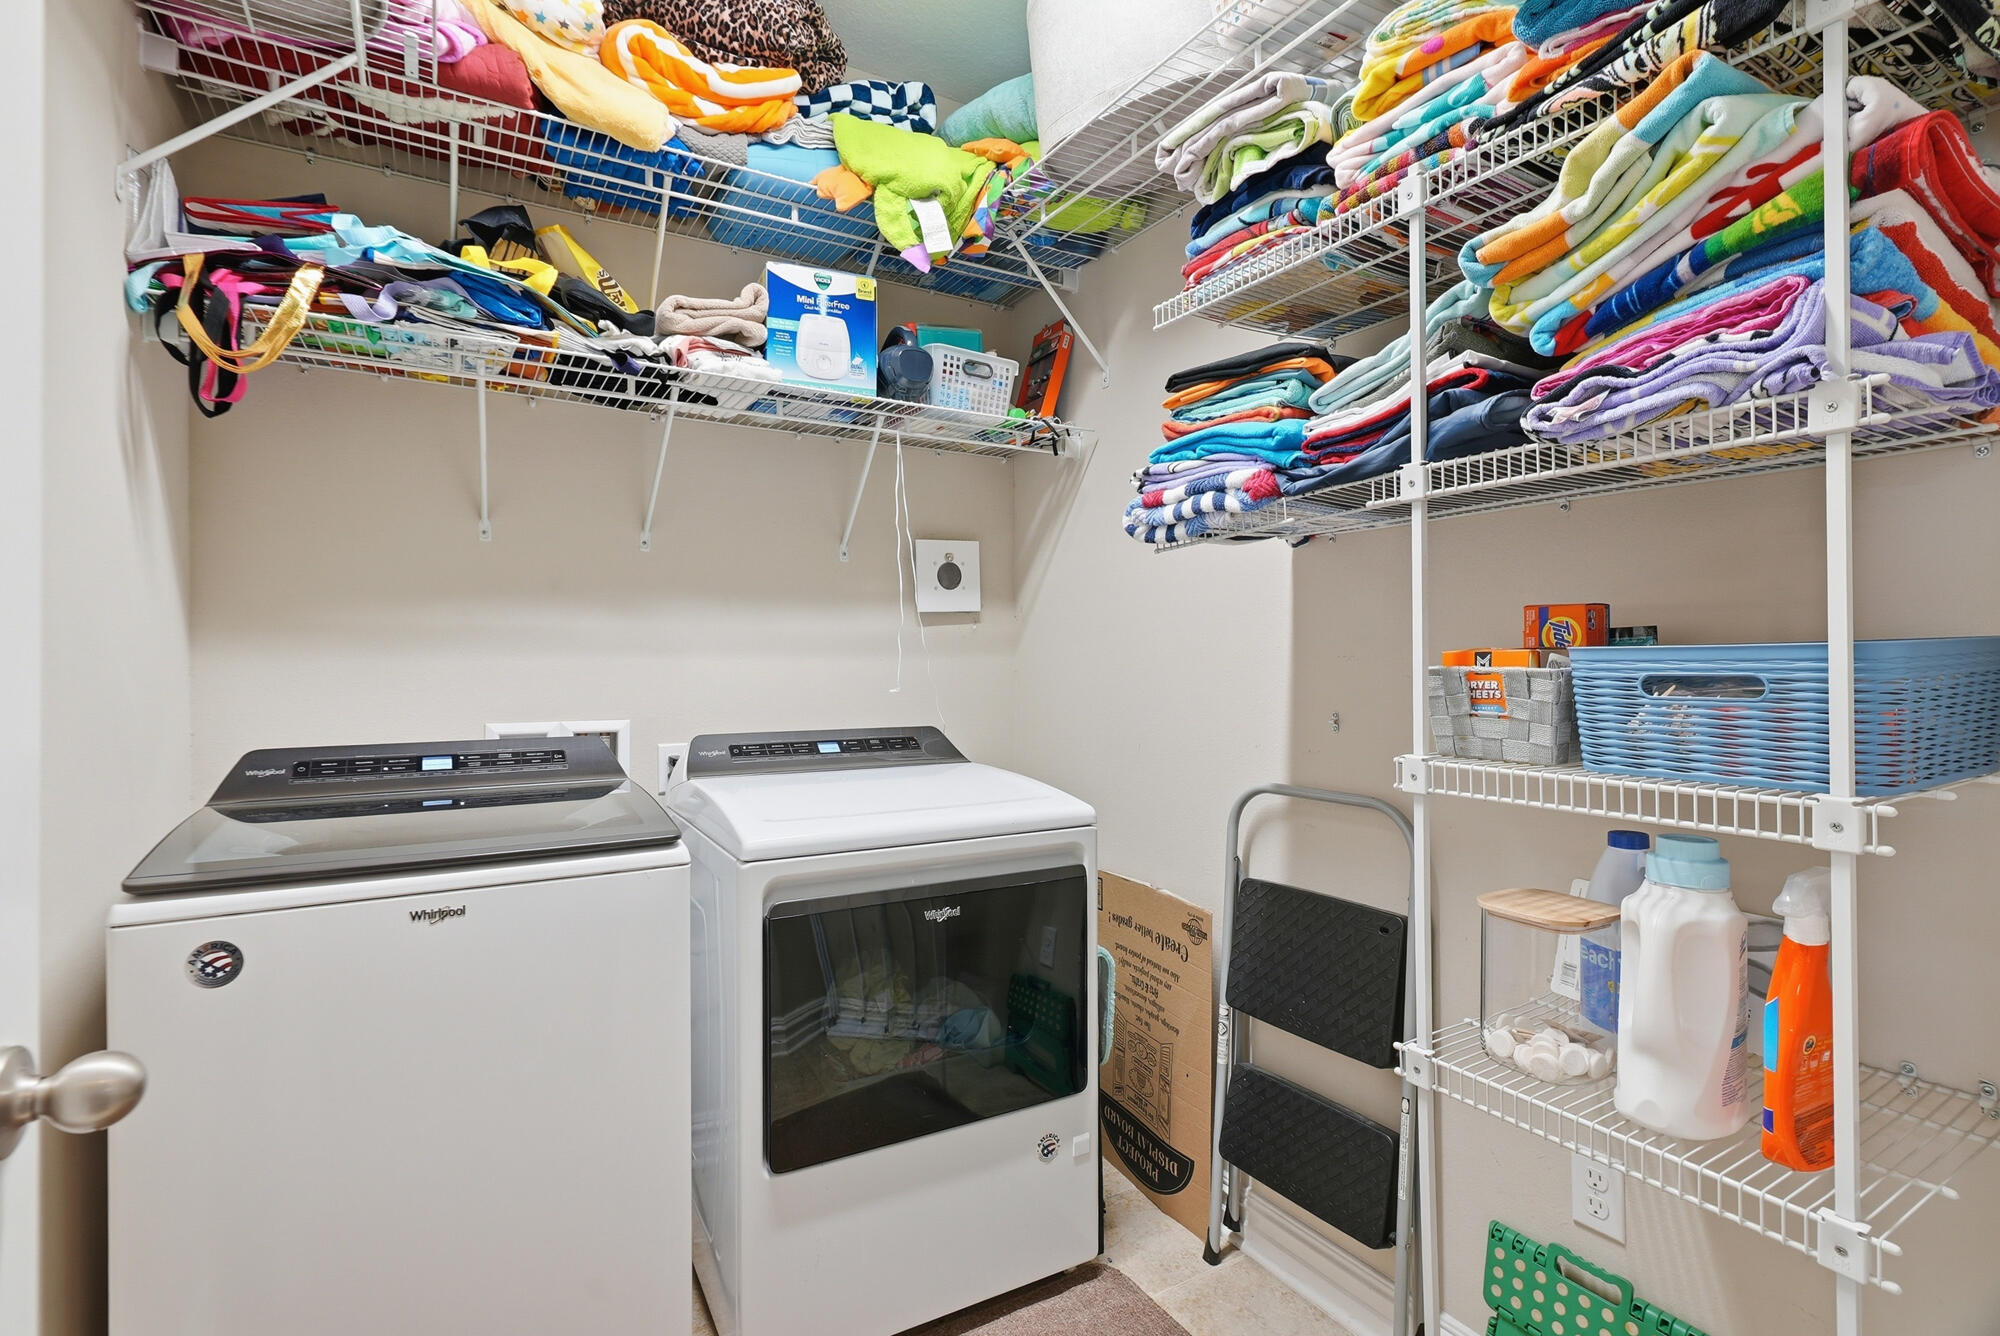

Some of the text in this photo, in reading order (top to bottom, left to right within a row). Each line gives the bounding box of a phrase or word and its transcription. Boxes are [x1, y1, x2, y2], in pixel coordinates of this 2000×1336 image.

[796, 294, 814, 305] Mini
[1468, 680, 1499, 690] RYER
[1470, 689, 1502, 699] HEETS
[698, 750, 726, 758] Whirlpool
[245, 768, 286, 778] Whirlpool
[409, 905, 467, 924] Whirlpool
[924, 906, 961, 922] Whirlpool
[1134, 921, 1155, 943] better
[187, 942, 239, 966] AMERICA
[1156, 931, 1189, 962] Create
[1104, 1105, 1135, 1138] BOARD
[1117, 1135, 1159, 1183] PROJECT
[1137, 1126, 1179, 1178] DISPLAY
